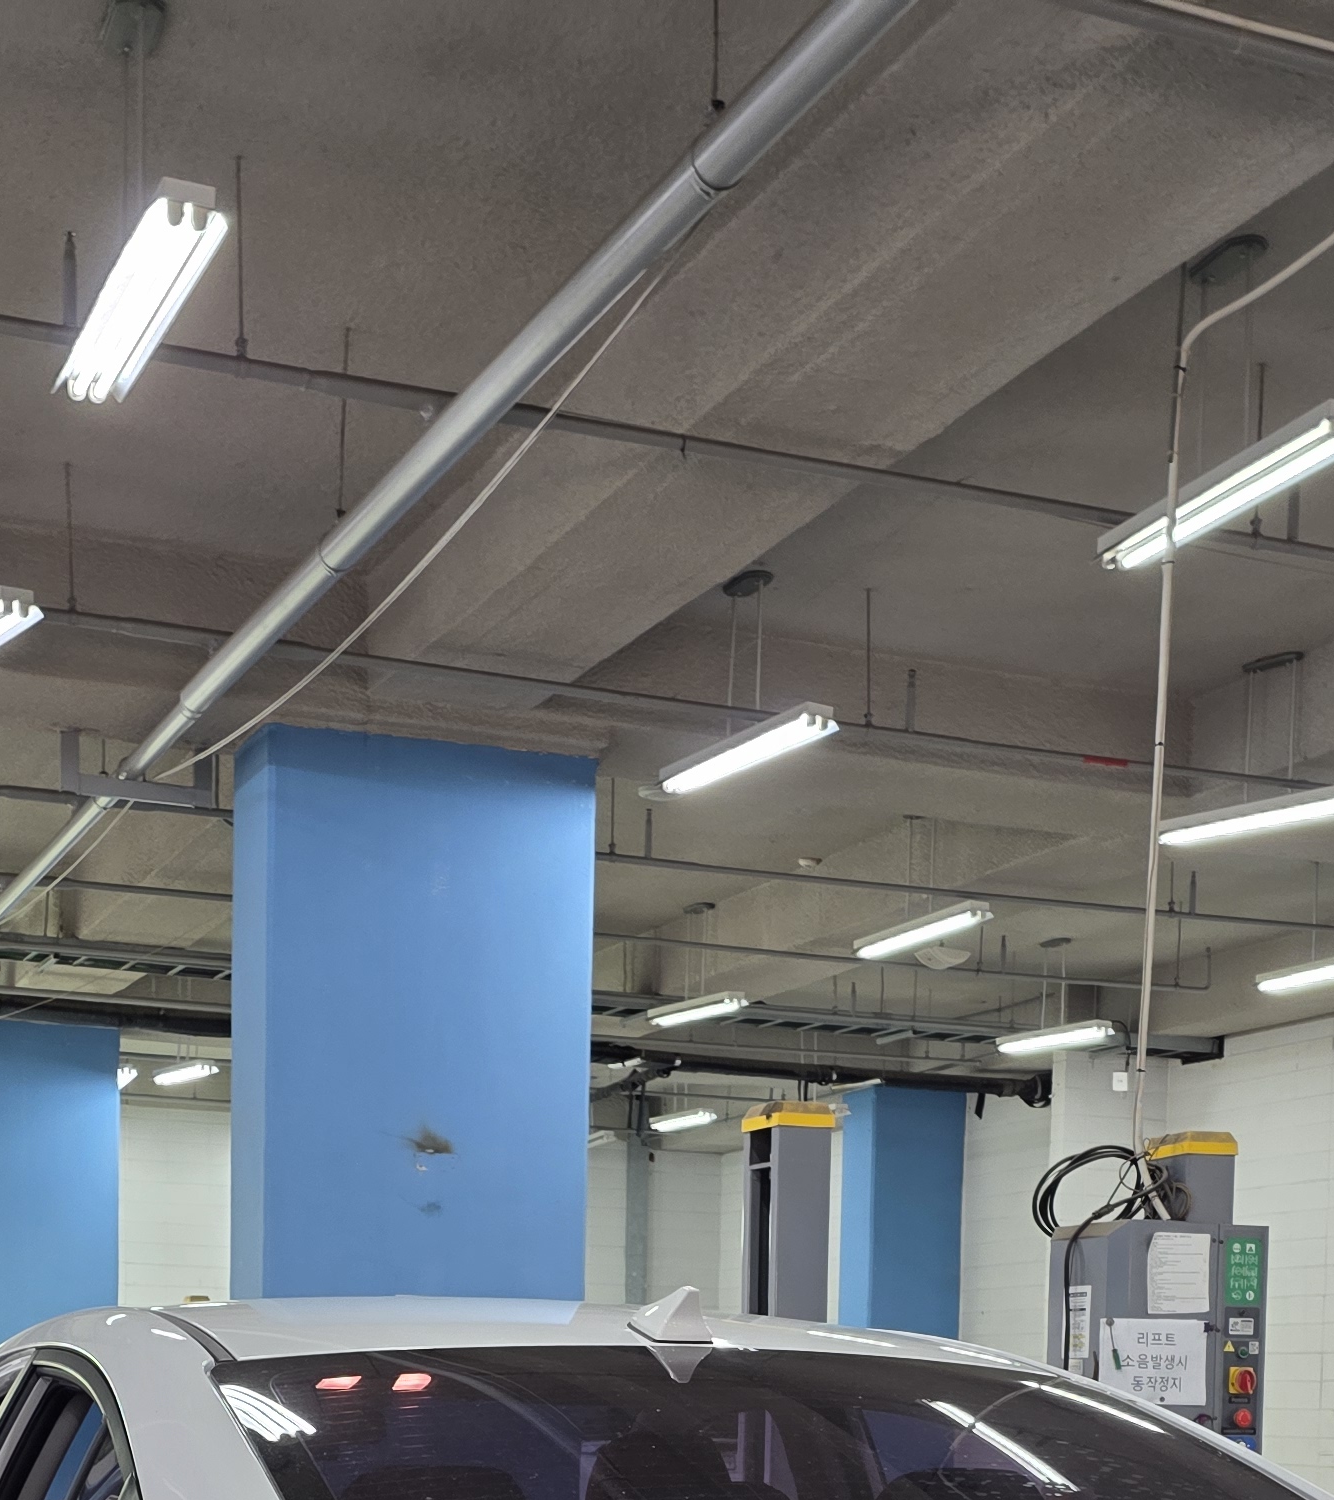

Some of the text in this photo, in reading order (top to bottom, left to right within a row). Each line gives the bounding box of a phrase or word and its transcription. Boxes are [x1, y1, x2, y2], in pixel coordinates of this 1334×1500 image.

[1137, 1332, 1176, 1347] 리프트
[1121, 1353, 1188, 1370] 소음발생시
[1131, 1375, 1182, 1392] 동작정지
